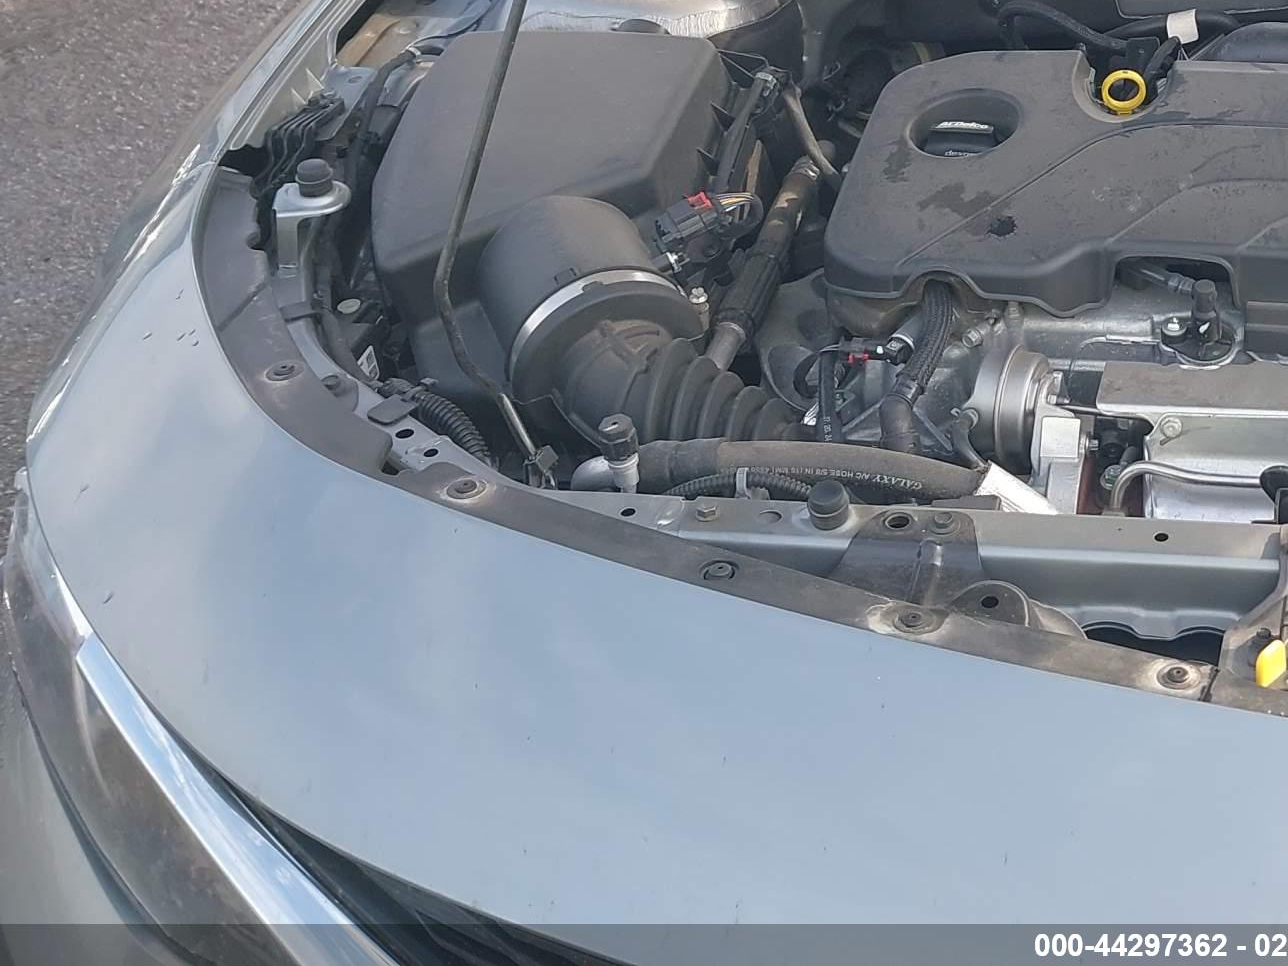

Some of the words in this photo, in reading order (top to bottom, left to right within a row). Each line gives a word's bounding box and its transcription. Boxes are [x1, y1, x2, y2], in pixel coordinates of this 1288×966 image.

[805, 467, 814, 475] IN
[829, 469, 854, 478] HOSE
[855, 472, 871, 480] A/C
[872, 474, 922, 490] GALAXY
